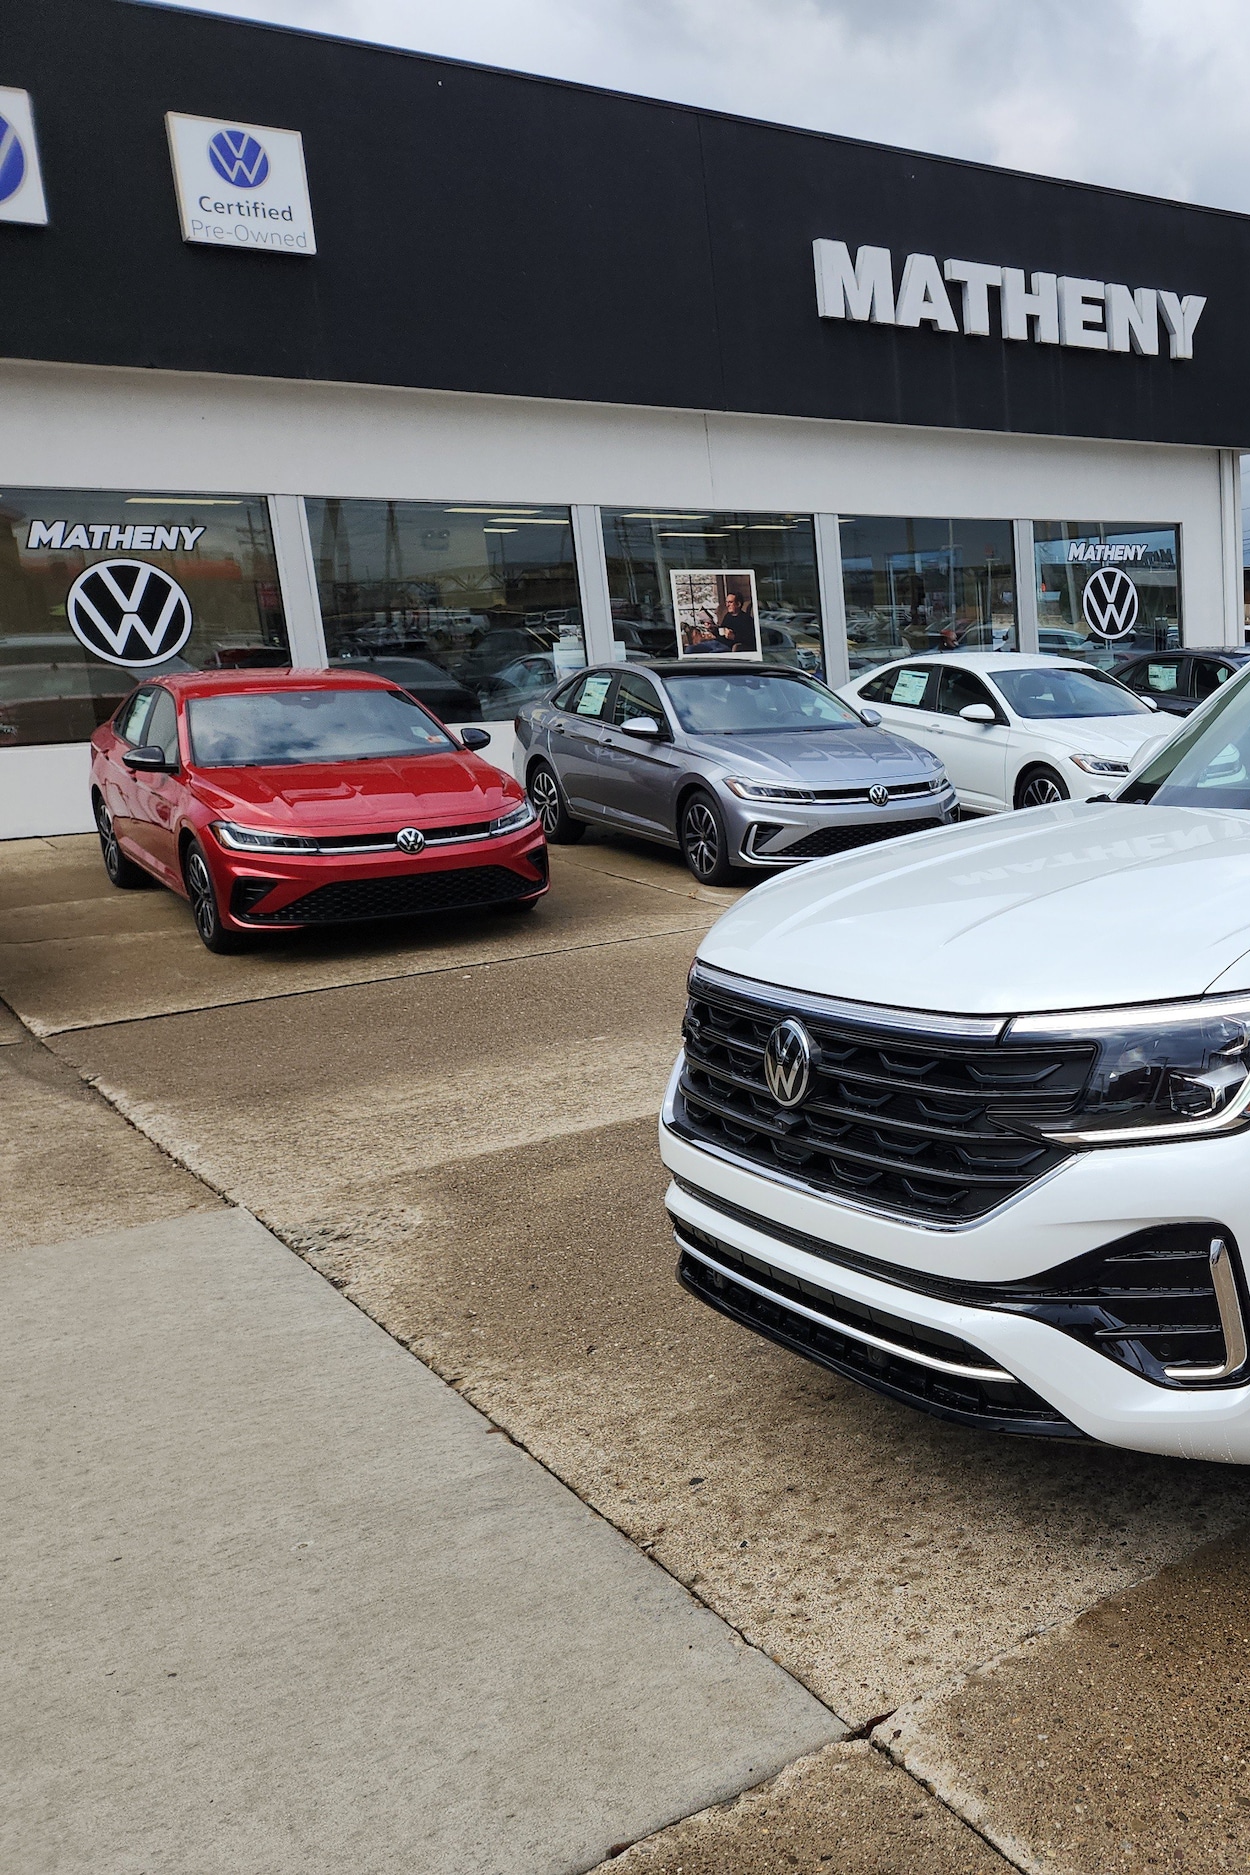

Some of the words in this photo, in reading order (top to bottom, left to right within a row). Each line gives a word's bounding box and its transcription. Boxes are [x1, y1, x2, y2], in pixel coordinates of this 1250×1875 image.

[207, 128, 271, 190] VW
[198, 195, 294, 222] Certified
[191, 219, 308, 248] Pre-Owned
[812, 237, 1208, 360] MATHENY
[27, 519, 206, 550] MATHENY
[1067, 542, 1148, 562] MATHENY
[66, 558, 192, 668] VW
[1083, 566, 1138, 640] VW
